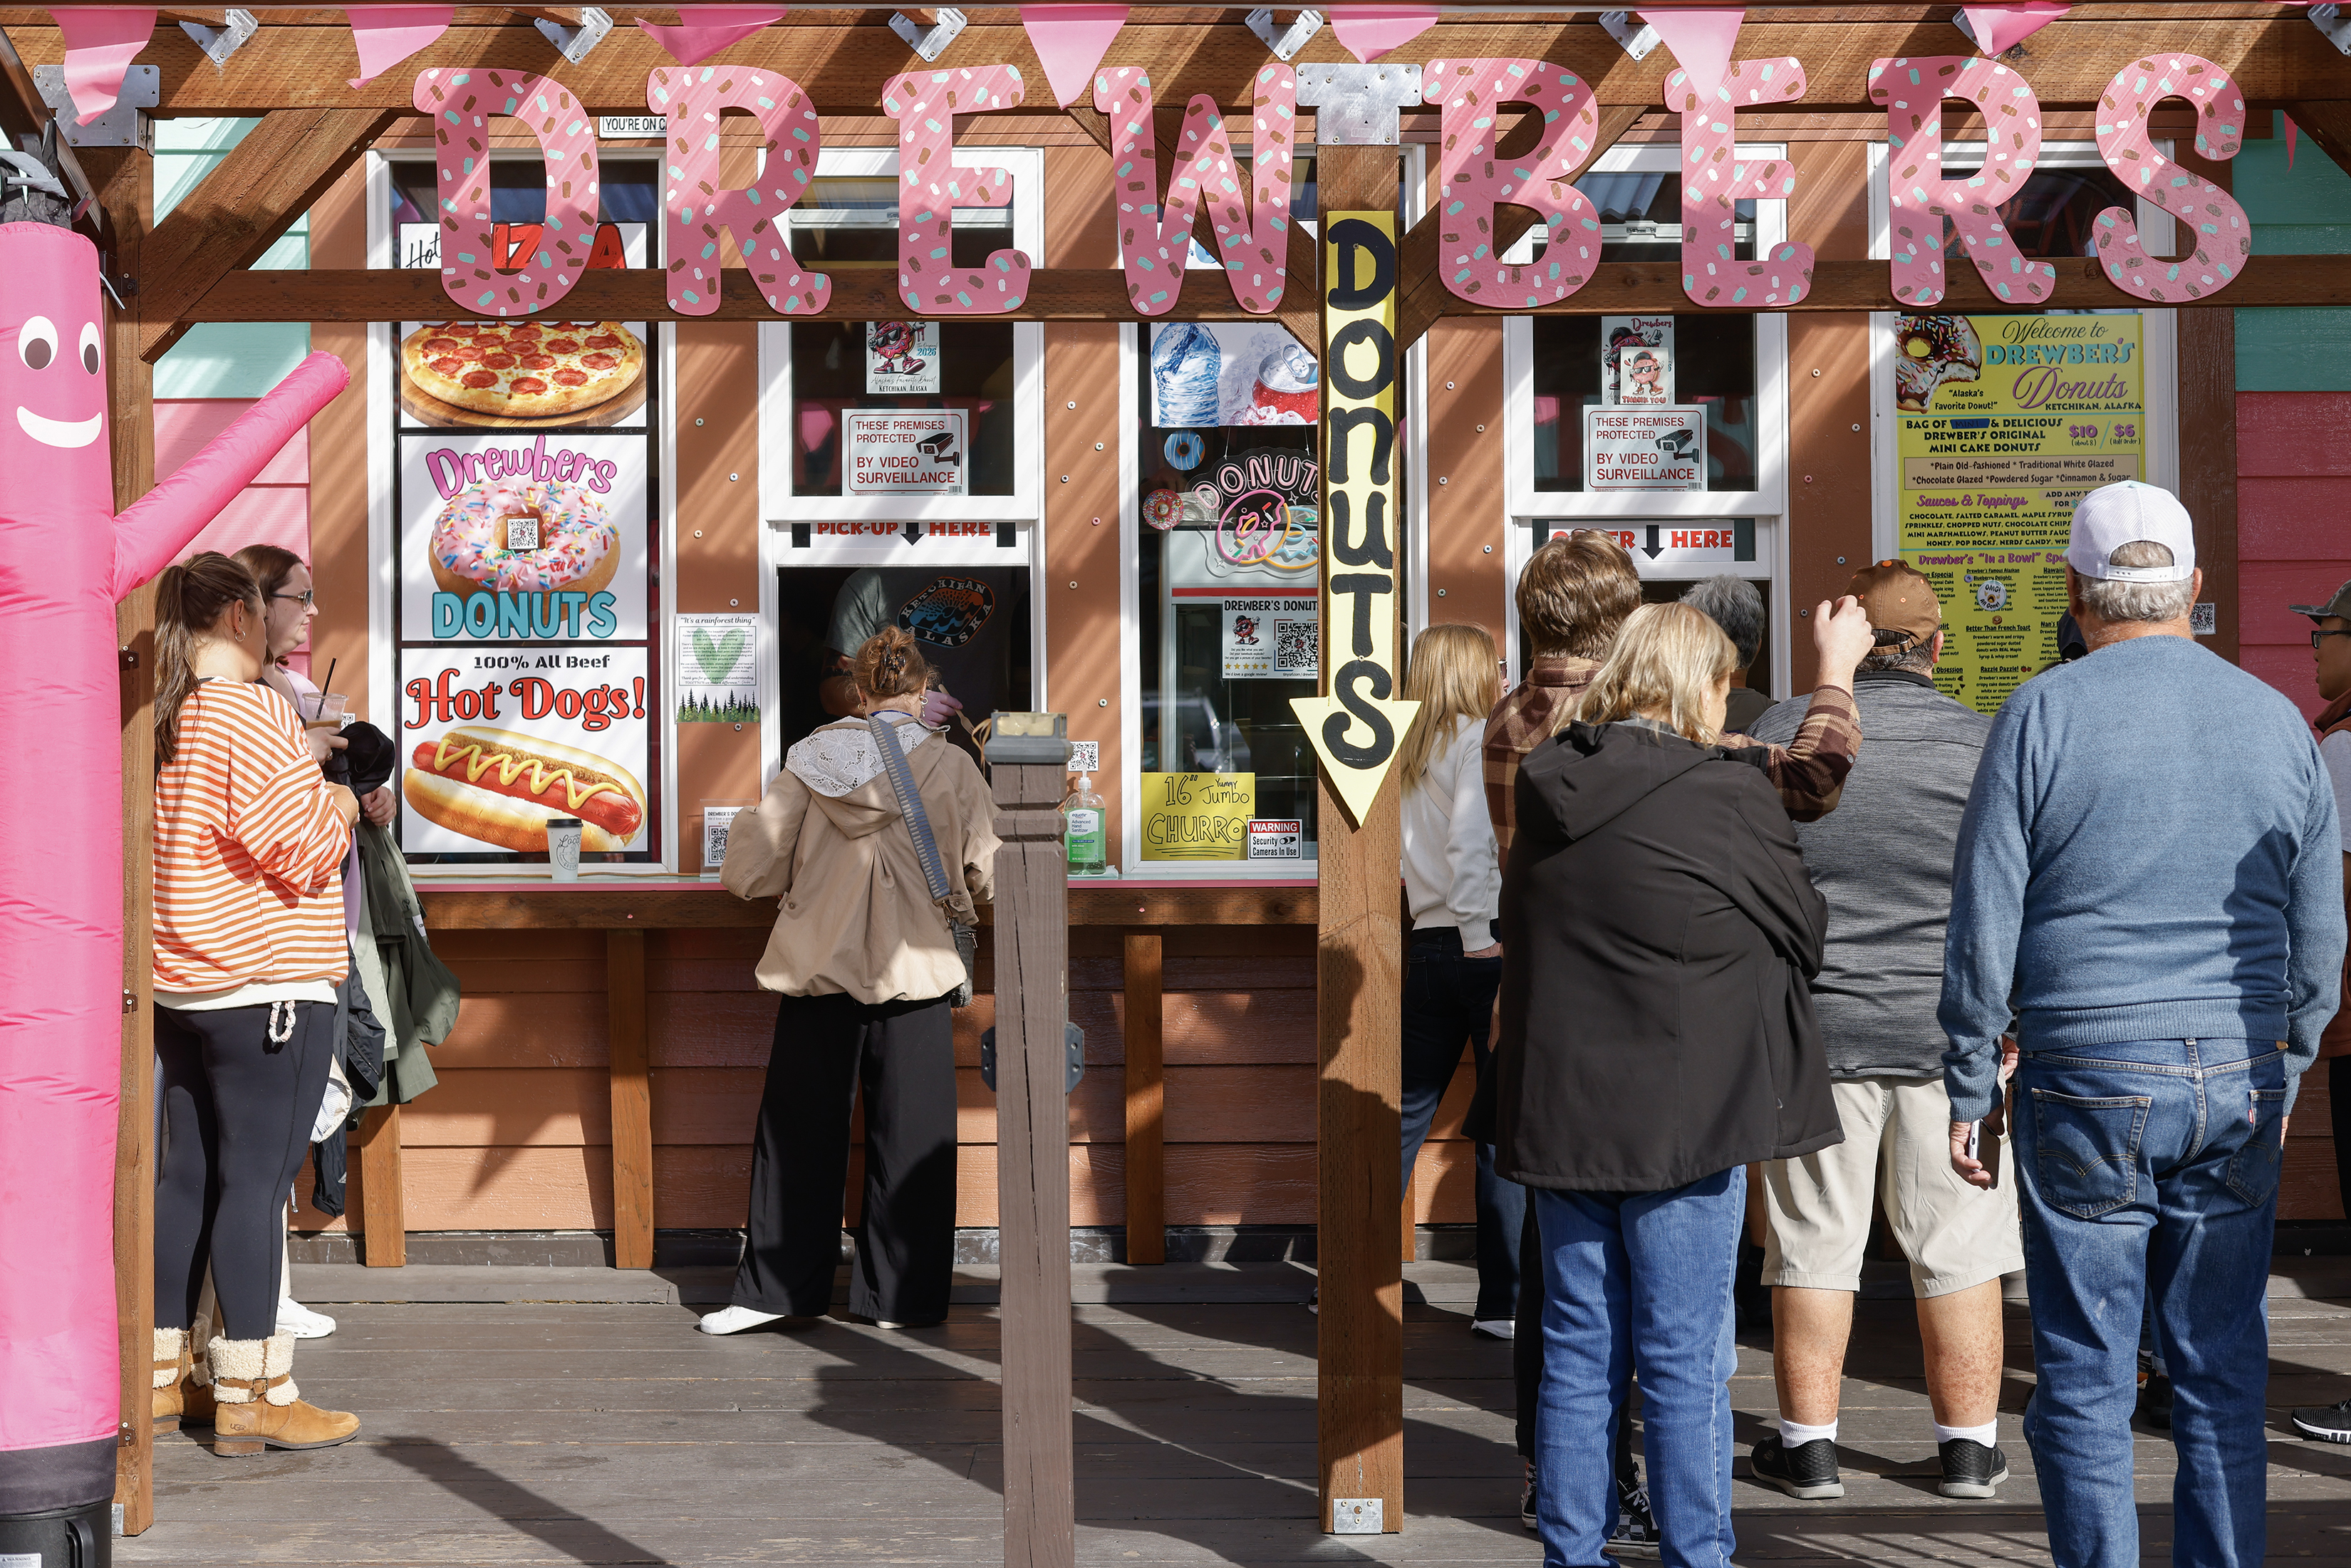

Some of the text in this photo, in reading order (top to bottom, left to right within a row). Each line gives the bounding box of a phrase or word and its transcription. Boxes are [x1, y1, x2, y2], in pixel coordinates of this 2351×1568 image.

[606, 118, 640, 130] YOU'RE
[643, 118, 656, 130] ON
[412, 53, 2251, 316] DREWBERS
[405, 232, 441, 269] Hot
[1631, 318, 1673, 331] Drewbers
[2002, 318, 2109, 343] Welcome to
[916, 348, 937, 356] 2026
[1986, 338, 2135, 365] DREWBER'S
[2013, 365, 2128, 409] Donuts
[1935, 401, 1966, 410] Favorite
[2045, 402, 2142, 411] KETCHIKAN, ALASKA
[856, 420, 945, 430] THESE PREMISES
[1595, 417, 1684, 427] THESE PREMISES
[1906, 420, 1929, 430] BAG
[1931, 420, 1947, 429] OF
[1991, 419, 2000, 427] &
[2003, 418, 2063, 427] DELICIOUS
[1596, 430, 1655, 440] PROTECTED
[1924, 430, 2046, 440] DREWBER'S ORIGINAL
[2069, 423, 2135, 439] $10 $6
[856, 434, 916, 443] PROTECTED
[1929, 442, 2041, 452] MINI CAKE DONUTS
[857, 456, 919, 468] BY VIDEO
[1597, 453, 1659, 464] BY VIDEO
[1956, 460, 2010, 469] Old-fashioned
[2018, 460, 2061, 469] Traditional
[2063, 460, 2085, 469] White
[2087, 459, 2114, 468] Glazed
[426, 435, 617, 499] Drewbers
[857, 472, 955, 484] SURVEILLANCE
[1597, 468, 1695, 480] SURVEILLANCE
[1957, 475, 1983, 484] Glazed
[2031, 474, 2053, 485] Sugar
[2099, 473, 2106, 482] &
[2108, 472, 2131, 482] Sugar
[1191, 455, 1317, 513] DONUT
[1916, 493, 2028, 509] Sauces & Toppings
[817, 522, 991, 537] PICK-UP HERE
[1671, 529, 1733, 549] HERE
[1919, 554, 1973, 565] Drewber's
[2045, 553, 2066, 566] Spe
[1985, 584, 2000, 593] OMG!
[1224, 600, 1318, 611] DREWBER'S DONUT
[432, 591, 617, 638] DONUTS
[701, 616, 733, 625] rainforest
[474, 655, 611, 670] 100% All Beef
[405, 668, 645, 732] Hot Dogs!
[1215, 778, 1237, 789] Yummy
[1199, 784, 1250, 804] Jumbo
[1147, 813, 1254, 844] CHURRO
[1252, 823, 1297, 832] WARNING
[1252, 836, 1278, 846] Security
[1252, 846, 1297, 856] Cameras In Use
